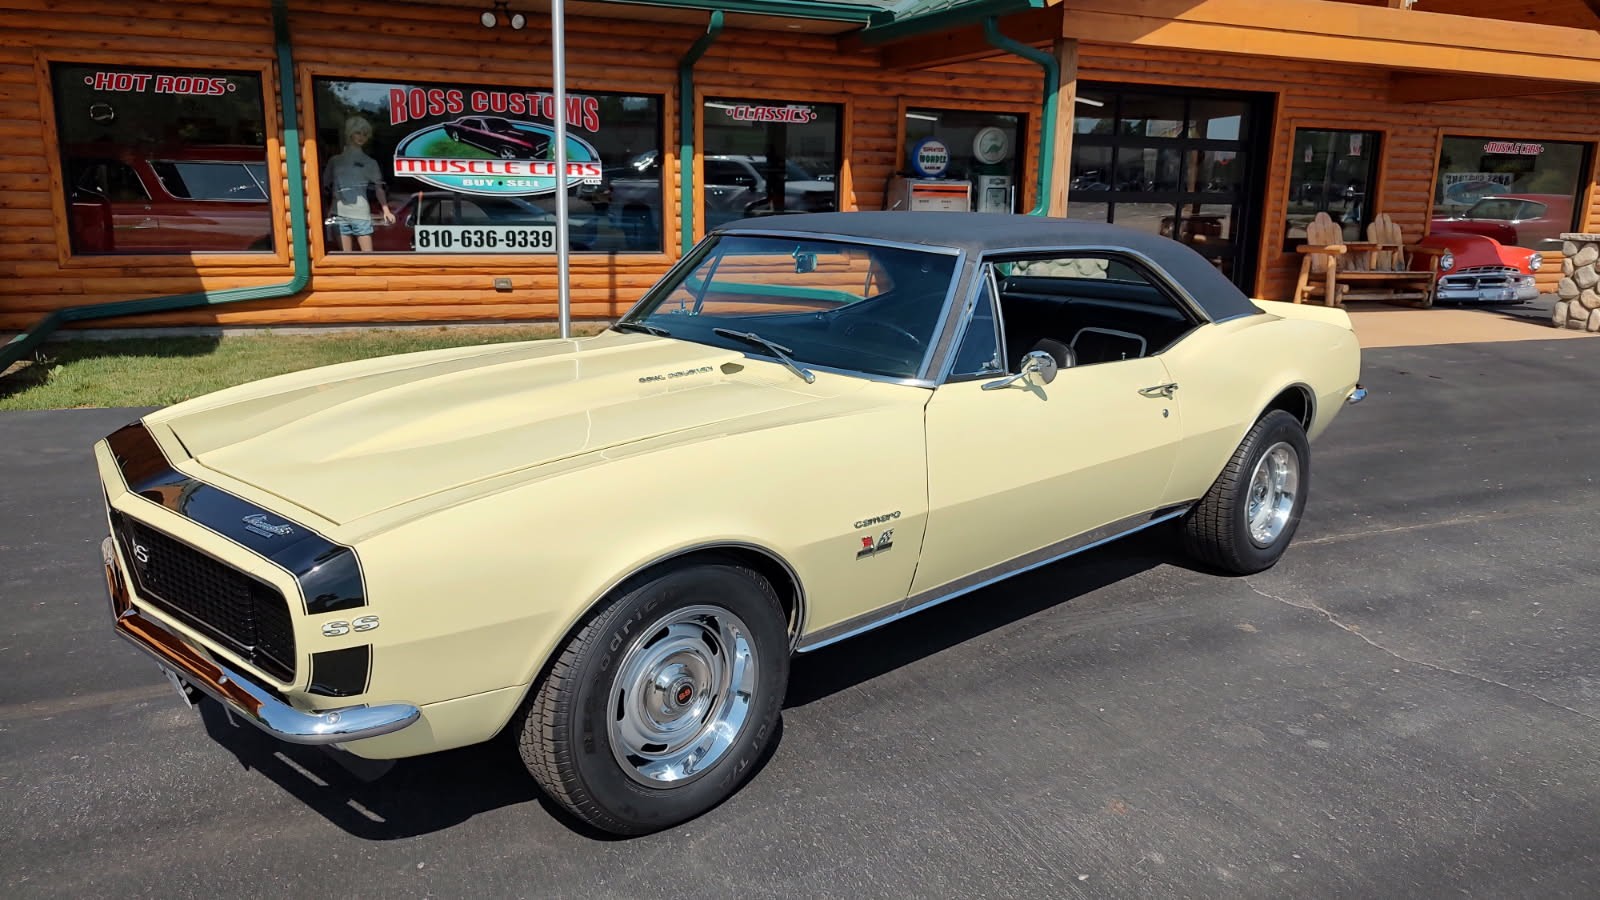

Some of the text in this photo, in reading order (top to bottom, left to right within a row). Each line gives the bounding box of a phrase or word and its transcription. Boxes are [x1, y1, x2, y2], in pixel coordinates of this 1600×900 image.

[94, 72, 227, 95] HOT RODS
[389, 88, 600, 132] ROSS CUSTOMS
[732, 105, 811, 123] CLASSICS
[1486, 141, 1541, 155] MUSCLE CARS
[395, 159, 521, 174] MUSCLE
[462, 178, 540, 187] BUY SELL
[418, 229, 553, 249] 810-636-9339
[853, 510, 901, 529] Camaro
[321, 615, 380, 638] SS
